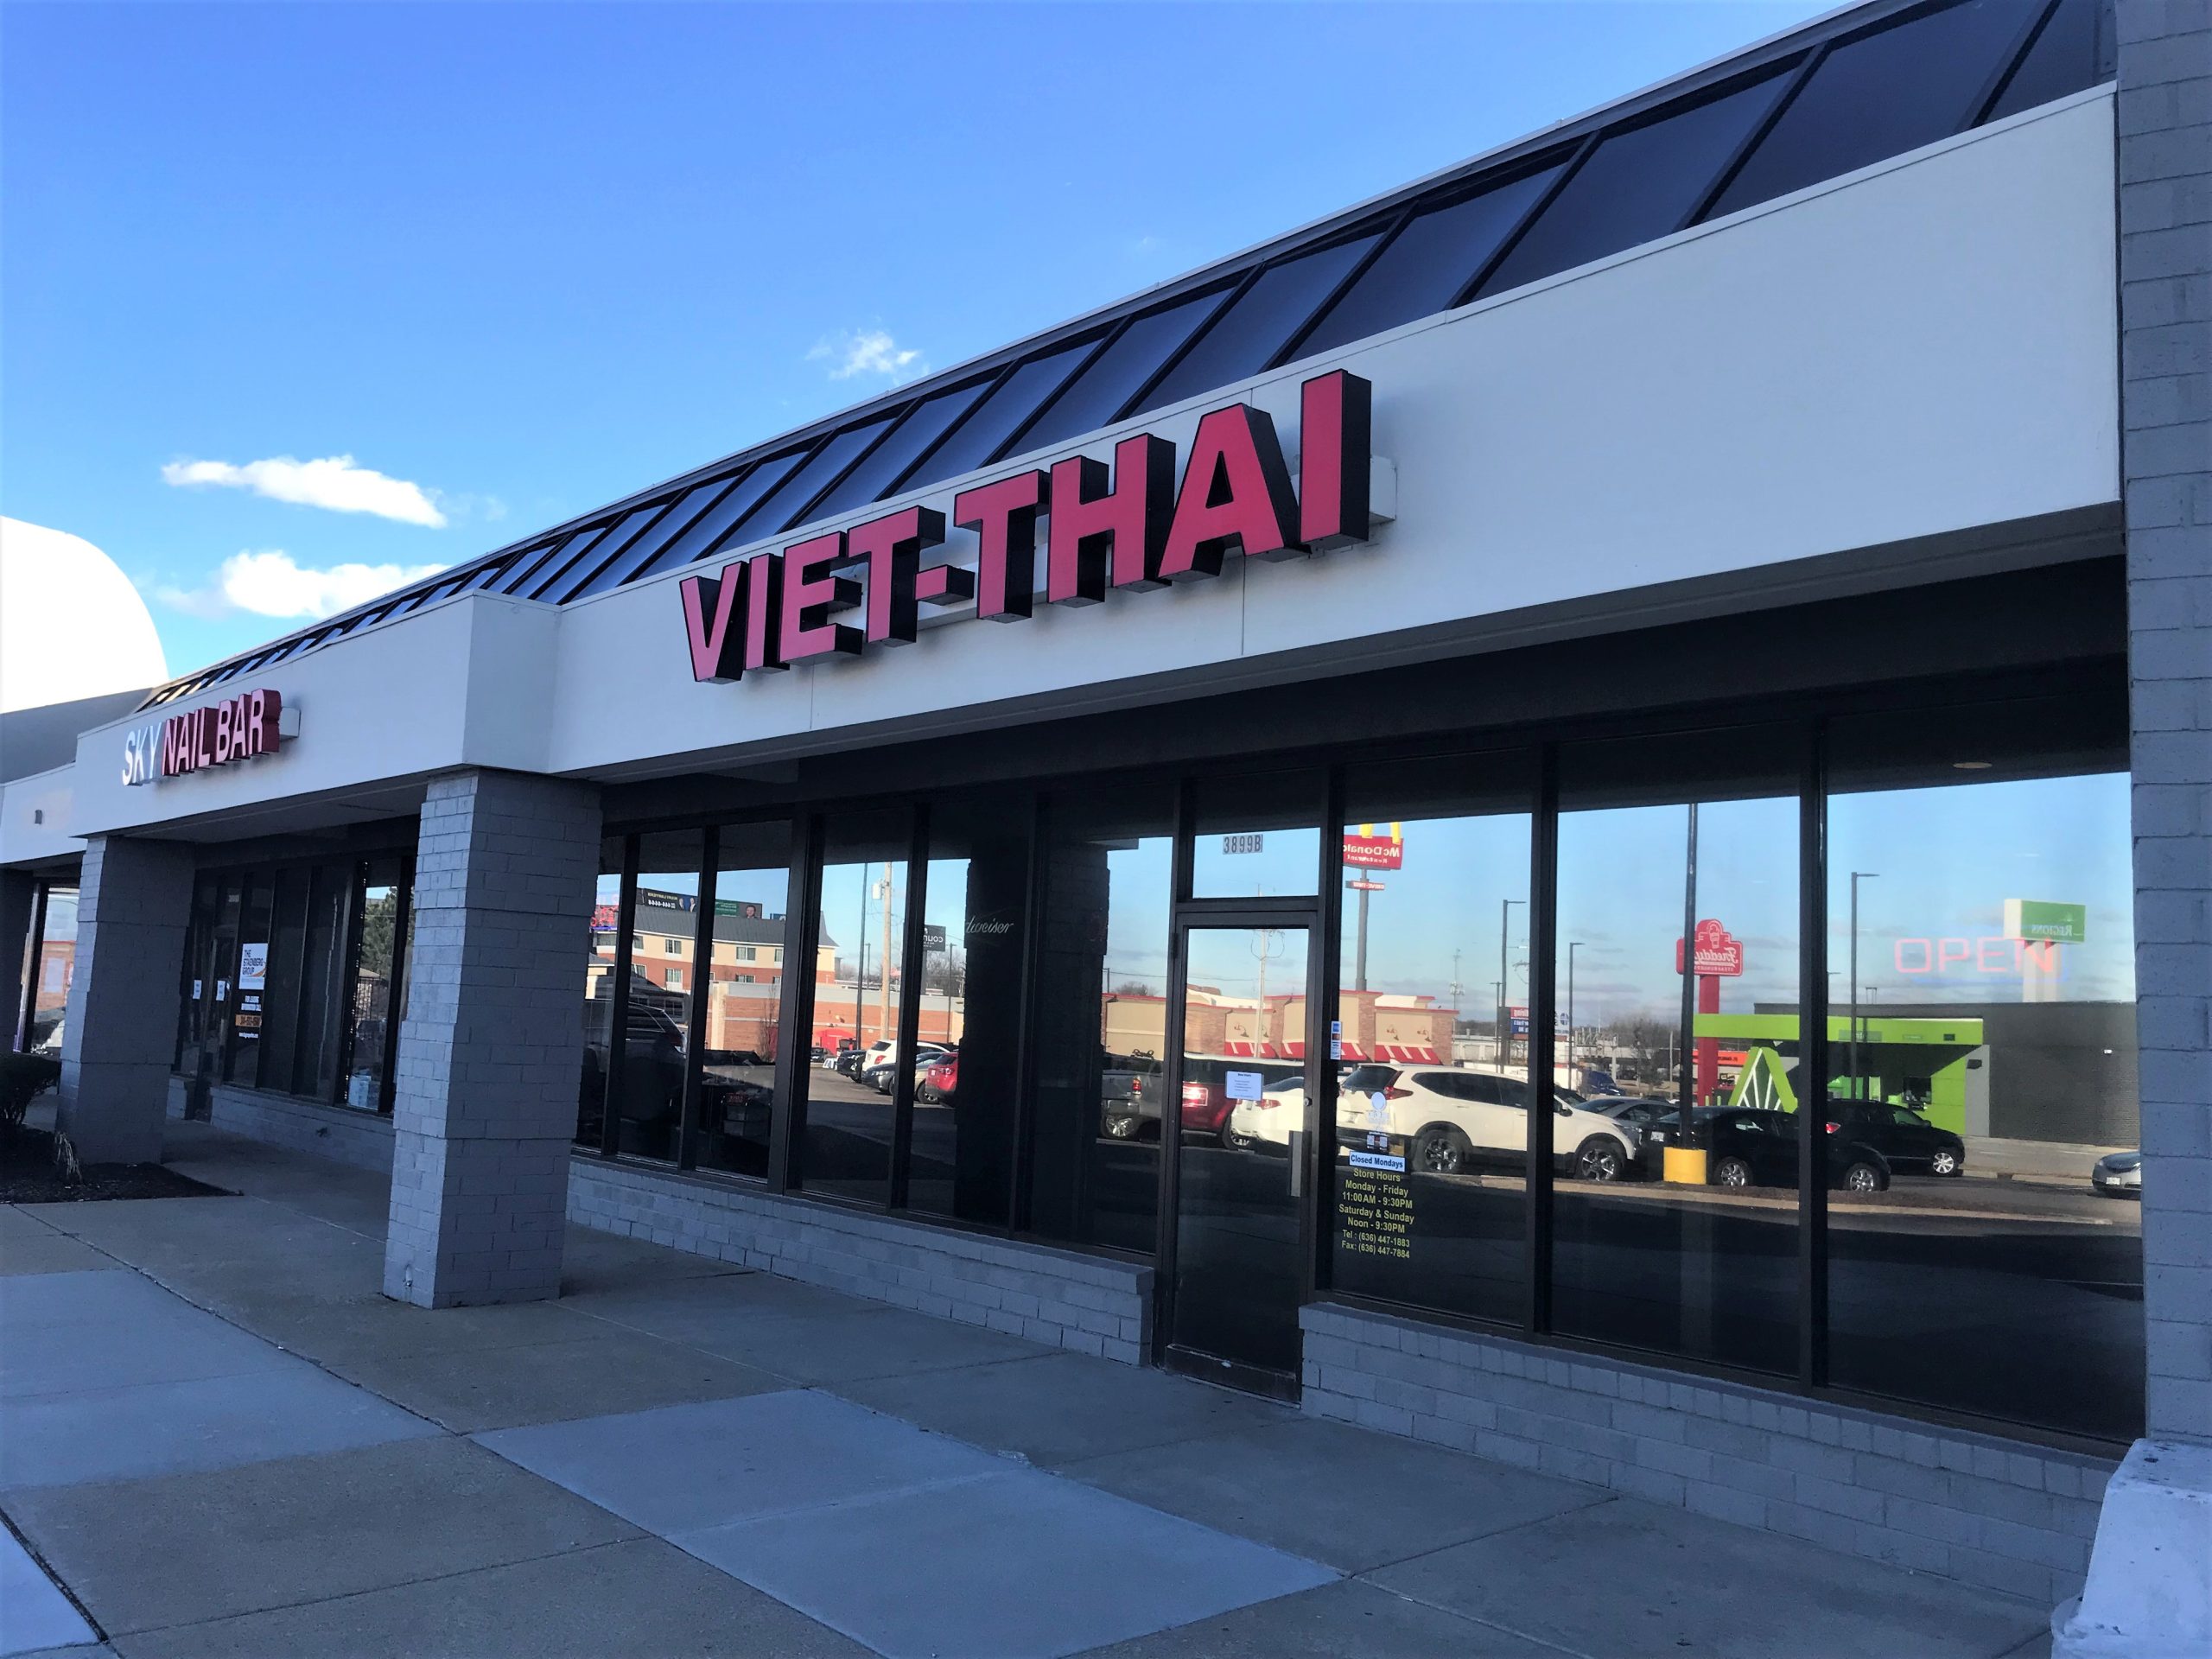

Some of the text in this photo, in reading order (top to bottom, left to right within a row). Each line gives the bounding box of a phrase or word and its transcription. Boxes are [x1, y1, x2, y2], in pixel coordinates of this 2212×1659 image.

[679, 369, 1370, 684] VIET-THAI
[122, 689, 273, 786] SKY NAIL BAR
[1224, 834, 1262, 854] 3899B
[965, 915, 1014, 933] dweiser
[1894, 938, 2061, 973] OPEN
[1351, 1154, 1403, 1169] Closed Mondays
[1353, 1167, 1401, 1182] Store Hours
[1345, 1179, 1376, 1193] Monday
[1383, 1185, 1408, 1198] Friday
[1382, 1197, 1413, 1209] 9:30PM
[1338, 1204, 1414, 1224] Saturday & Sunday
[1347, 1217, 1369, 1228] Noon
[1376, 1221, 1405, 1233] 9:30PM
[1358, 1232, 1376, 1244] (636)
[1341, 1240, 1357, 1250] Fax:
[1358, 1243, 1376, 1255] (636)
